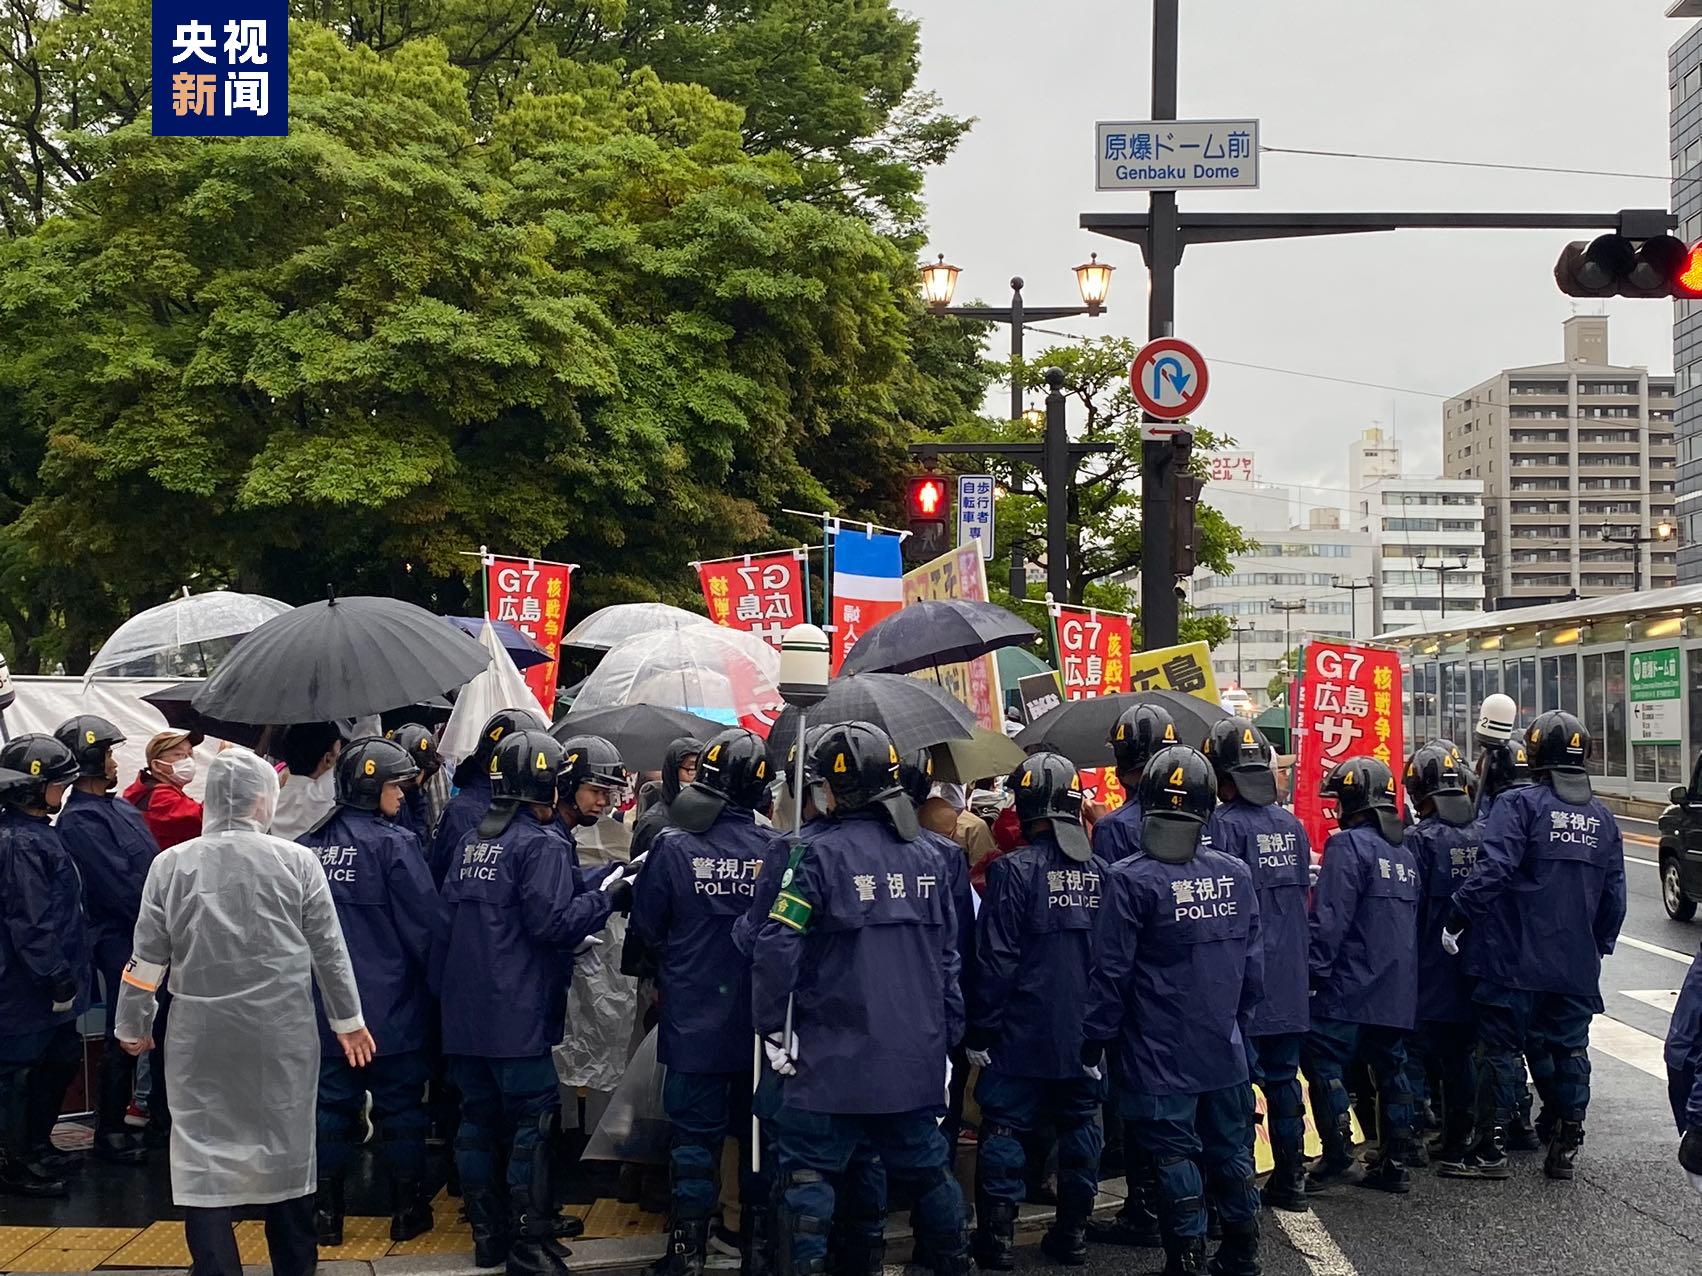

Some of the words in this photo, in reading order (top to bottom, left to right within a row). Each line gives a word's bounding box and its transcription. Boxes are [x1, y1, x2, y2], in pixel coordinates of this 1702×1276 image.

[1105, 131, 1250, 160] 原爆ドーム前
[1116, 165, 1186, 180] Genbaku
[1194, 164, 1239, 179] Dome
[963, 482, 975, 523] 自転車
[977, 482, 990, 523] 歩行者
[498, 568, 540, 592] G7
[497, 596, 541, 622] 広島
[1063, 620, 1102, 650] G7
[1065, 655, 1102, 687] 広島
[1316, 650, 1364, 681] G7
[1314, 682, 1369, 717] 広島
[85, 730, 96, 744] 6
[489, 726, 504, 742] 4
[1116, 724, 1125, 741] 4
[1164, 723, 1175, 740] 4
[1243, 728, 1255, 744] 4
[1531, 728, 1540, 743] 4
[1570, 732, 1581, 748] 4
[420, 738, 428, 751] 6
[707, 744, 721, 762] 4
[536, 752, 548, 770] 4
[834, 753, 847, 773] 4
[888, 744, 898, 764] 4
[1444, 755, 1453, 769] 4
[1516, 749, 1527, 763] 4
[30, 760, 41, 775] 6
[364, 759, 377, 775] 6
[490, 755, 498, 773] 4
[756, 761, 766, 780] 4
[1020, 770, 1033, 788] 4
[1070, 773, 1080, 791] 4
[1169, 767, 1184, 786] 4
[1343, 771, 1354, 785] 4
[1387, 777, 1394, 792] 4
[1550, 811, 1600, 834] 警視庁
[1256, 832, 1297, 854] 警視庁
[1550, 831, 1599, 849] POLICE
[853, 872, 936, 901] 警視庁
[1046, 870, 1100, 893] 警視庁
[1171, 875, 1235, 905] 警視庁
[1048, 894, 1100, 909] POLICE
[1174, 901, 1237, 922] POLICE
